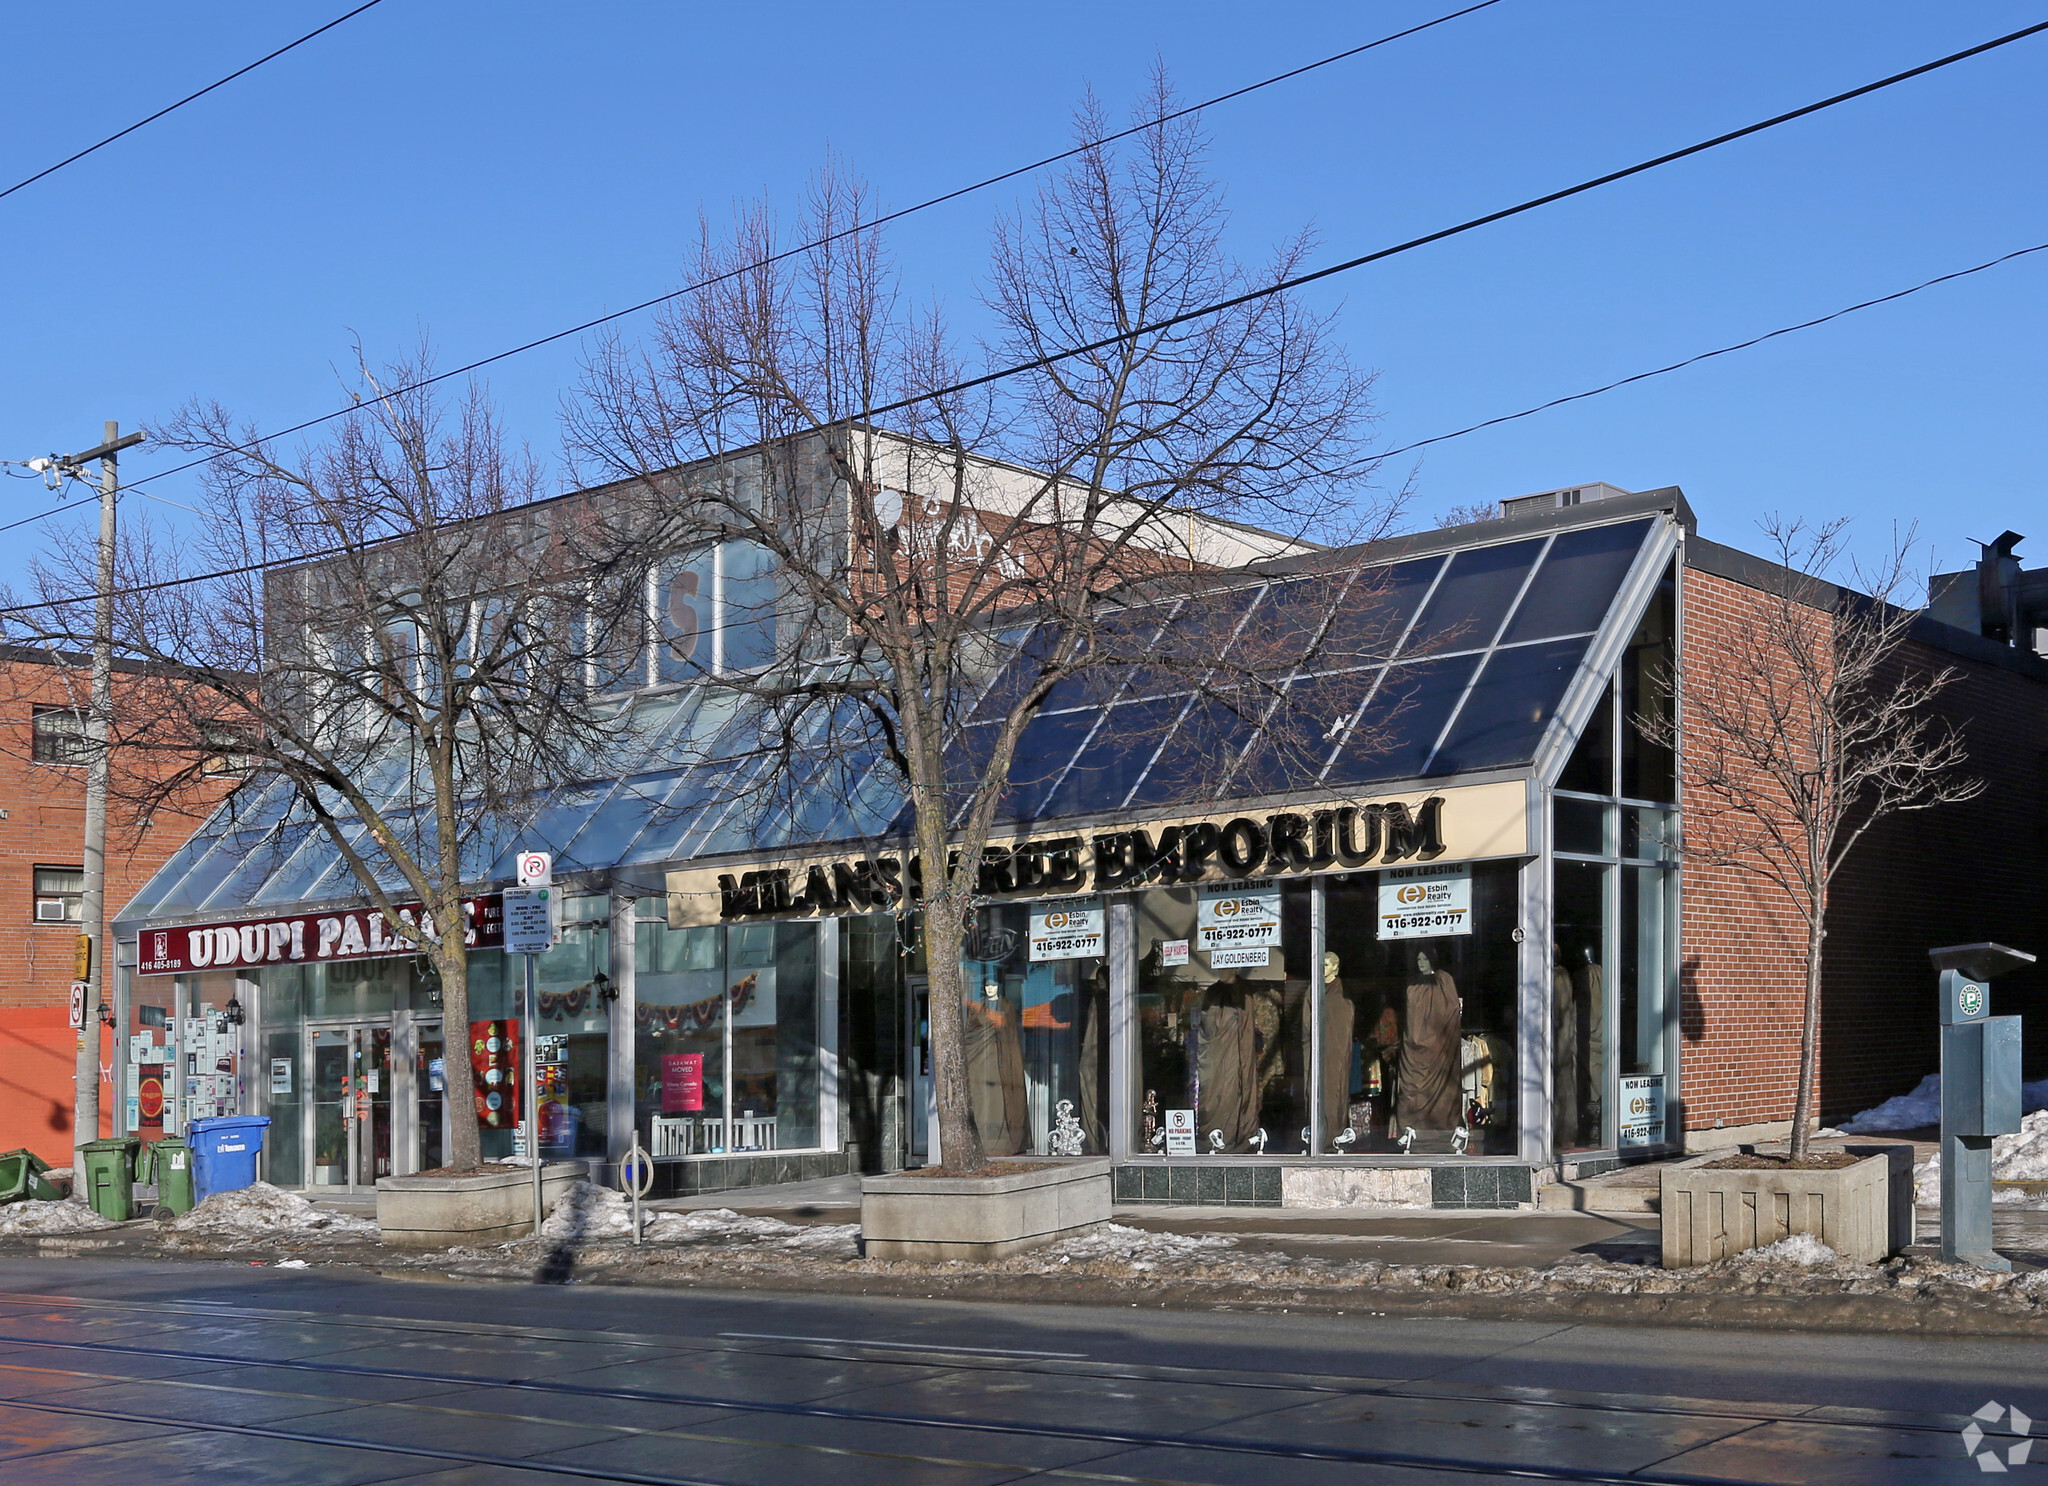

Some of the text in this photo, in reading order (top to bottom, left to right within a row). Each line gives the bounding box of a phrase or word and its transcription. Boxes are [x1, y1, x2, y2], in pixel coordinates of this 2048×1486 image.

[907, 836, 1086, 898] REE
[1092, 796, 1447, 892] EMPORIUM
[1390, 863, 1463, 879] NOW LEASING
[1207, 880, 1273, 893] NOW LEASING
[1427, 884, 1448, 892] Esbin
[484, 907, 500, 918] PURE
[1241, 906, 1263, 914] Realty
[1069, 918, 1088, 926] Realty
[187, 919, 305, 968] UDUPI
[141, 958, 181, 970] 416 405-8189
[1213, 952, 1266, 965] JAY GOLDENBERG
[1625, 1078, 1663, 1089] NOW LEASING
